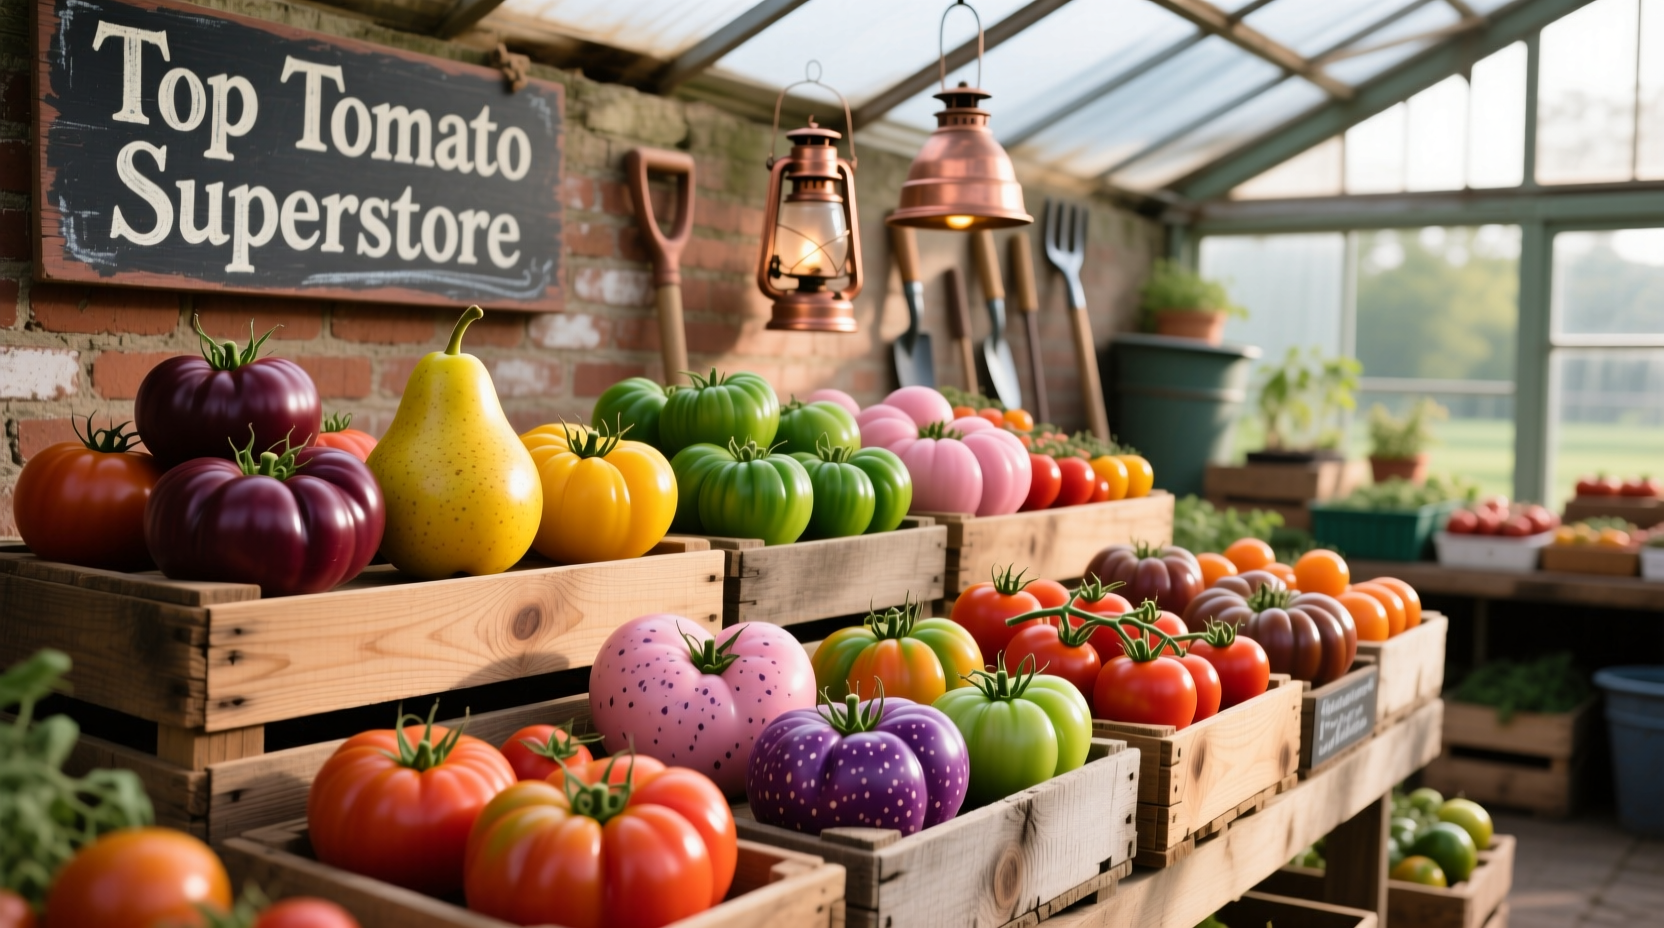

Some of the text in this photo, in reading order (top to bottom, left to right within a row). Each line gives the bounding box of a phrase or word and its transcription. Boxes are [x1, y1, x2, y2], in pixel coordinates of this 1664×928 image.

[92, 19, 532, 181] Top Tomato
[110, 140, 521, 274] Superstore
